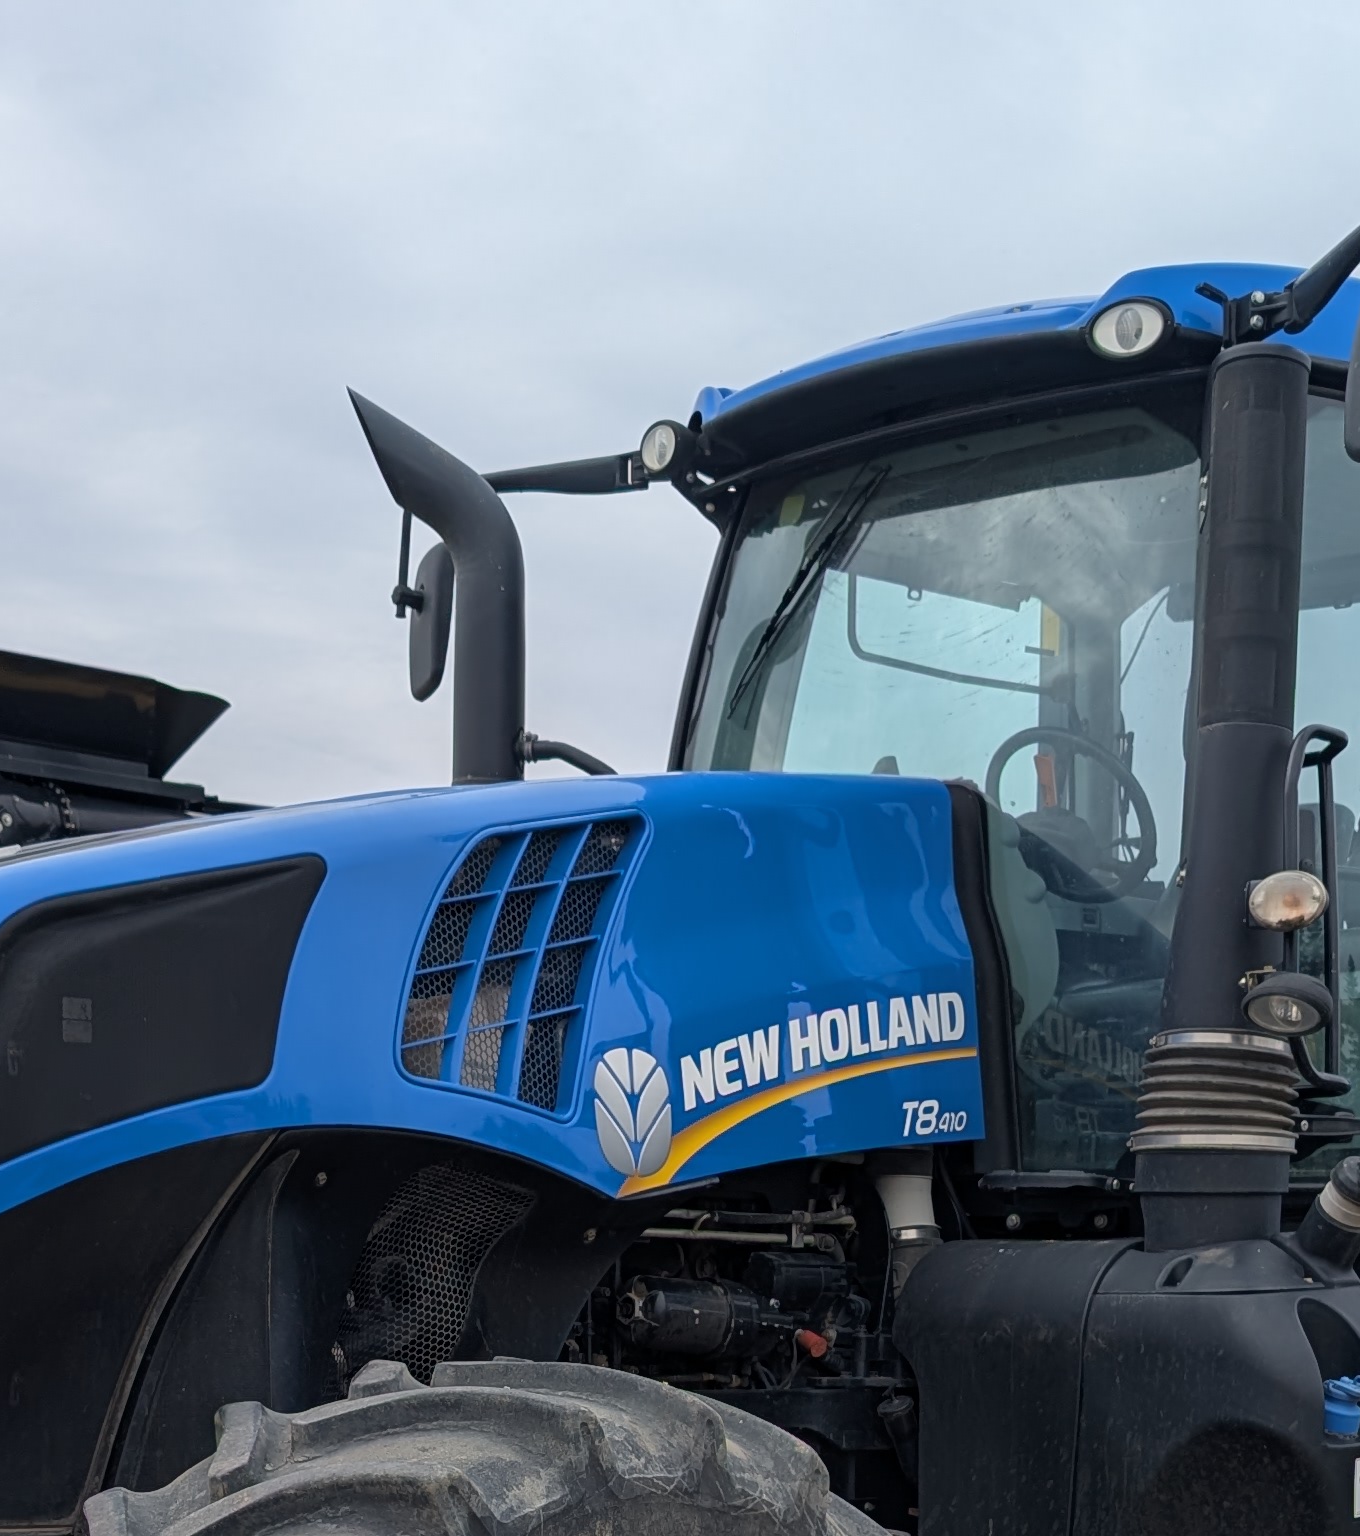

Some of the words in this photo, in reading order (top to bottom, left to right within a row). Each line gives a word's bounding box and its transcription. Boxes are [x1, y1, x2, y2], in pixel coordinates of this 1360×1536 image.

[680, 1024, 780, 1112] NEW
[788, 992, 966, 1073] HOLLAND
[902, 1099, 968, 1138] T8.410
